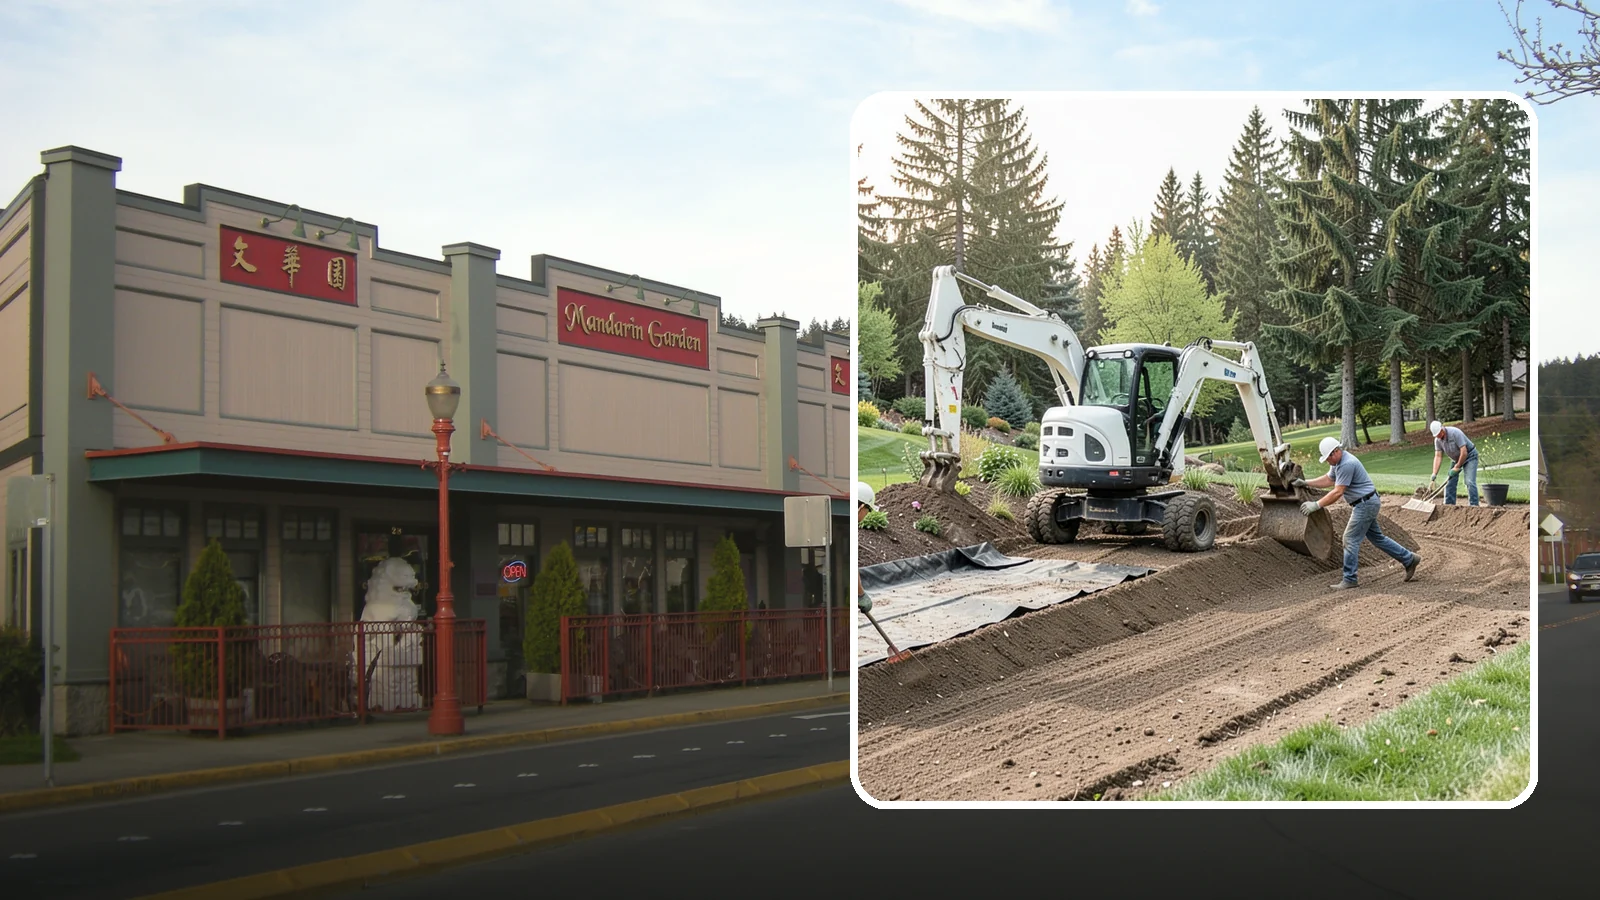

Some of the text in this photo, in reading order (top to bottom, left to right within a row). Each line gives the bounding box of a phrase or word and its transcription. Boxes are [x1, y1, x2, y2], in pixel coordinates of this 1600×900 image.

[230, 235, 346, 291] 文華園
[564, 302, 701, 352] Mandarin Garden
[834, 363, 846, 386] 文
[503, 565, 527, 578] OPEN
